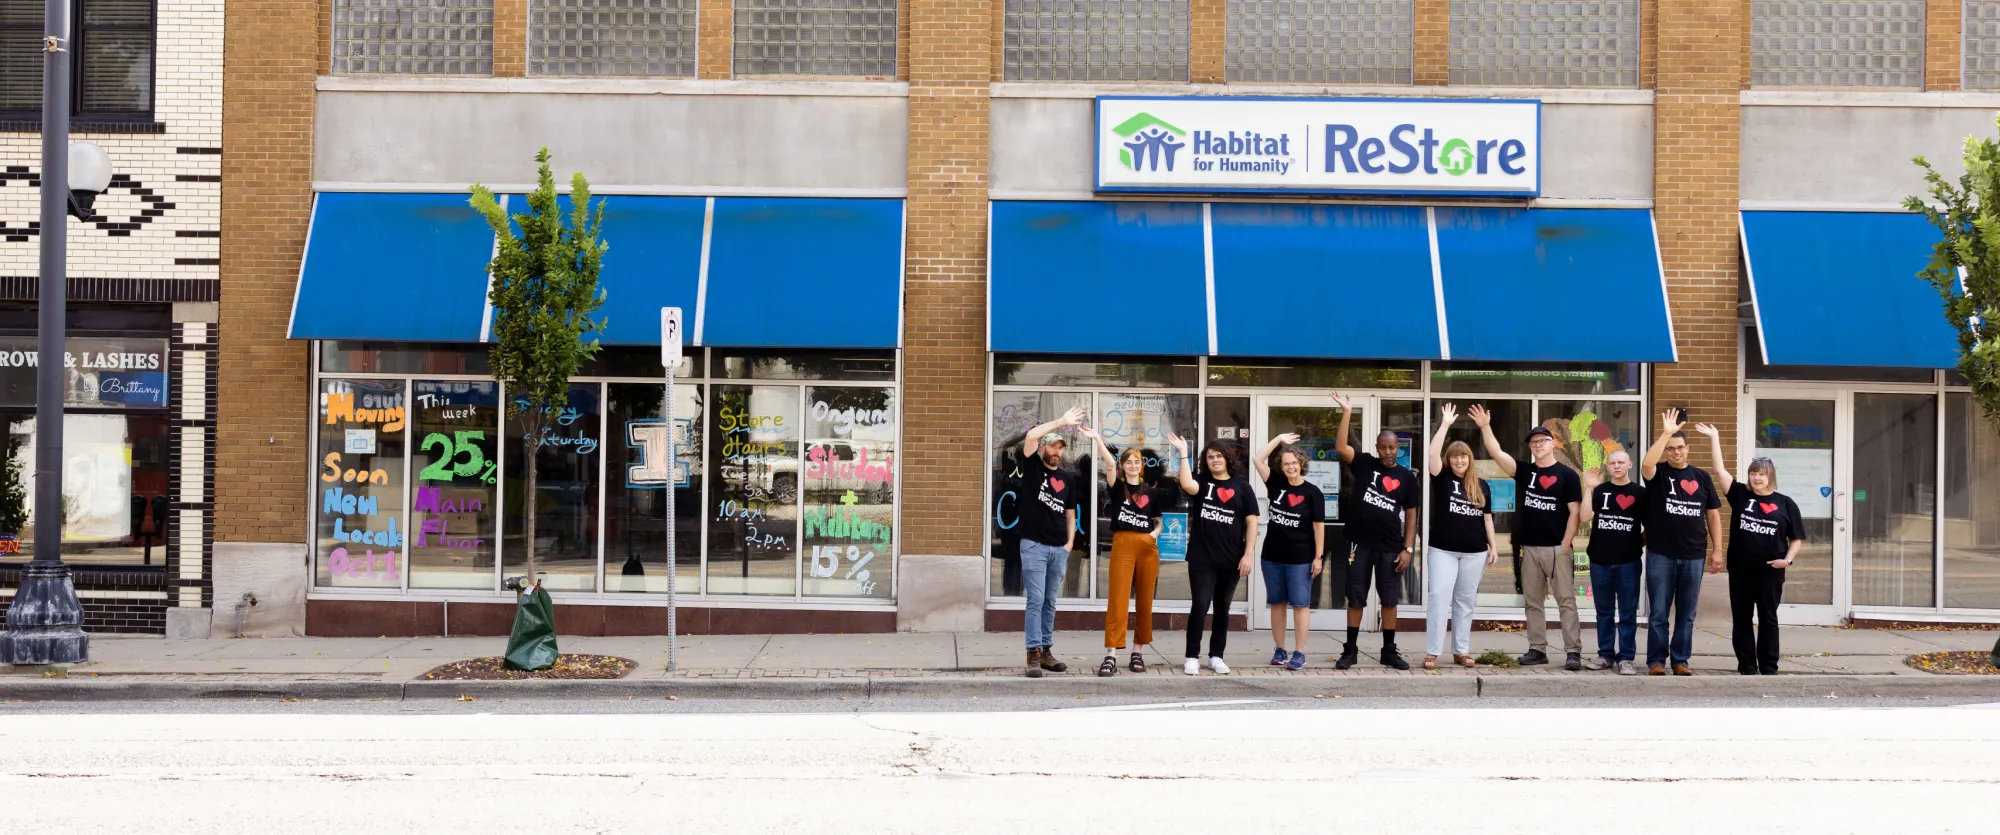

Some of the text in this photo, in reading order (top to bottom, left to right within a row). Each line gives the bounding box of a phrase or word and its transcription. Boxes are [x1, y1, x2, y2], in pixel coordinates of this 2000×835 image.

[1193, 130, 1290, 156] Habitat
[1324, 123, 1526, 176] ReStore
[1193, 157, 1289, 174] for Humanity
[82, 352, 160, 369] LASHES
[84, 377, 160, 402] by Brittany
[417, 394, 450, 409] This
[325, 392, 405, 433] Moving
[442, 404, 476, 419] week
[719, 407, 784, 431] Store
[1101, 410, 1169, 439] 2nd
[722, 435, 787, 457] Hours
[420, 430, 497, 485] 25%
[807, 447, 893, 484] Student
[321, 452, 389, 485] Soon
[1370, 470, 1380, 488] I
[1452, 480, 1462, 494] I
[1528, 472, 1537, 489] I
[1668, 476, 1676, 495] I
[744, 484, 774, 498] Sat
[1204, 482, 1216, 500] I
[1274, 490, 1286, 504] I
[324, 487, 378, 515] New
[414, 486, 482, 515] Main
[719, 500, 736, 517] 10
[1363, 491, 1394, 512] ReStore
[1450, 502, 1483, 516] ReStore
[1524, 496, 1556, 511] ReStore
[1602, 492, 1612, 510] I
[1666, 502, 1700, 516] ReStore
[1744, 498, 1757, 512] I
[1118, 512, 1150, 528] ReStore
[1200, 508, 1234, 524] ReStore
[1598, 518, 1632, 532] ReStore
[416, 518, 485, 549] Floor
[745, 526, 762, 543] 2
[804, 506, 890, 552] Military
[1740, 520, 1776, 536] ReStore
[328, 547, 378, 579] Oct
[810, 545, 875, 581] 15%
